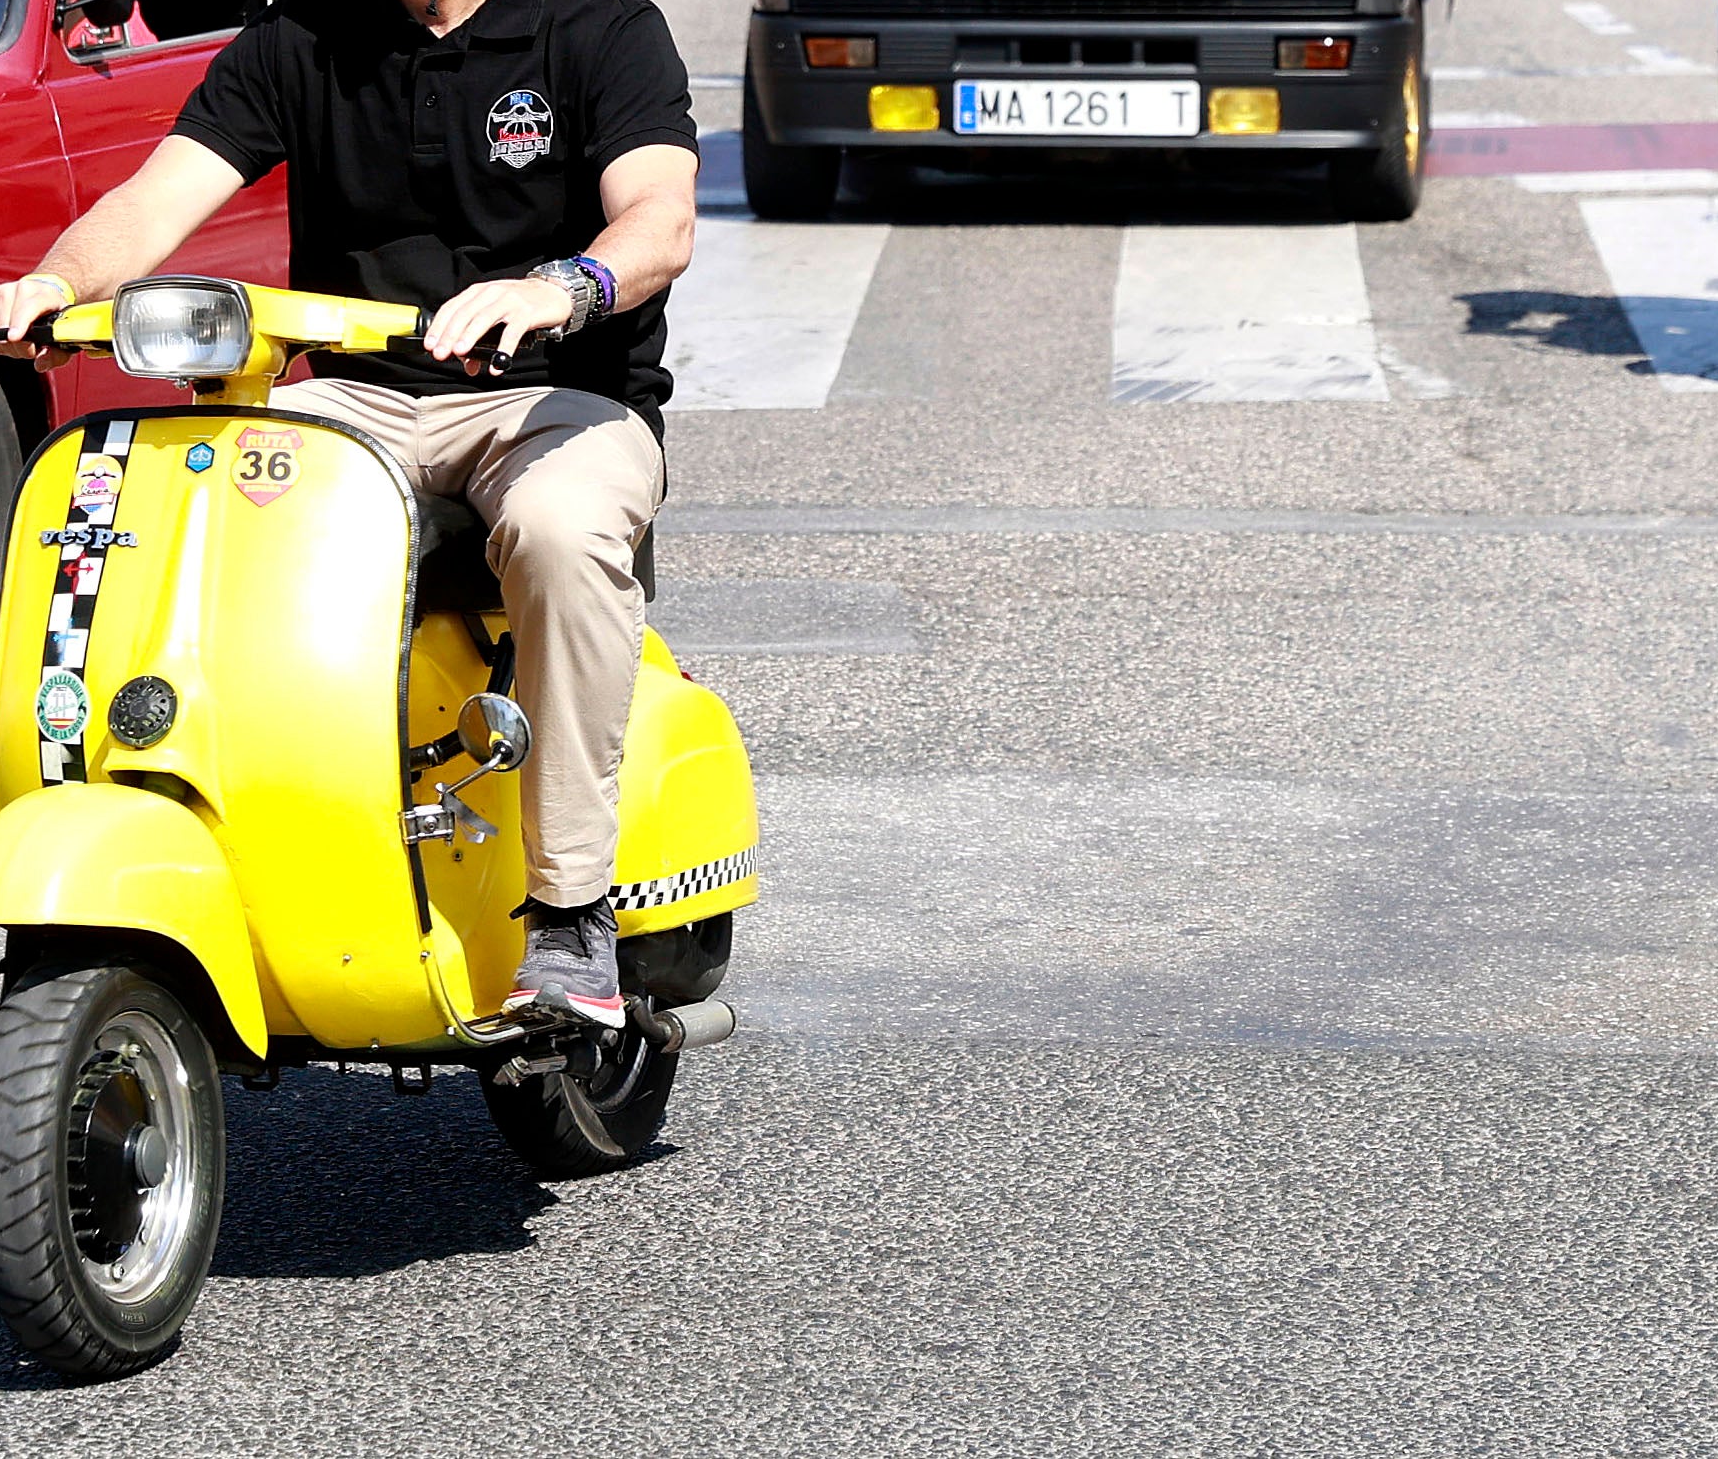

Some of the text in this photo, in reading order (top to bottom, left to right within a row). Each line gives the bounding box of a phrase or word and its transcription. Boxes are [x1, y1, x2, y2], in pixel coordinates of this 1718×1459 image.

[980, 90, 1192, 127] MA 1261 T
[245, 433, 293, 448] RUTA
[239, 450, 292, 482] 36
[40, 527, 139, 550] vespa
